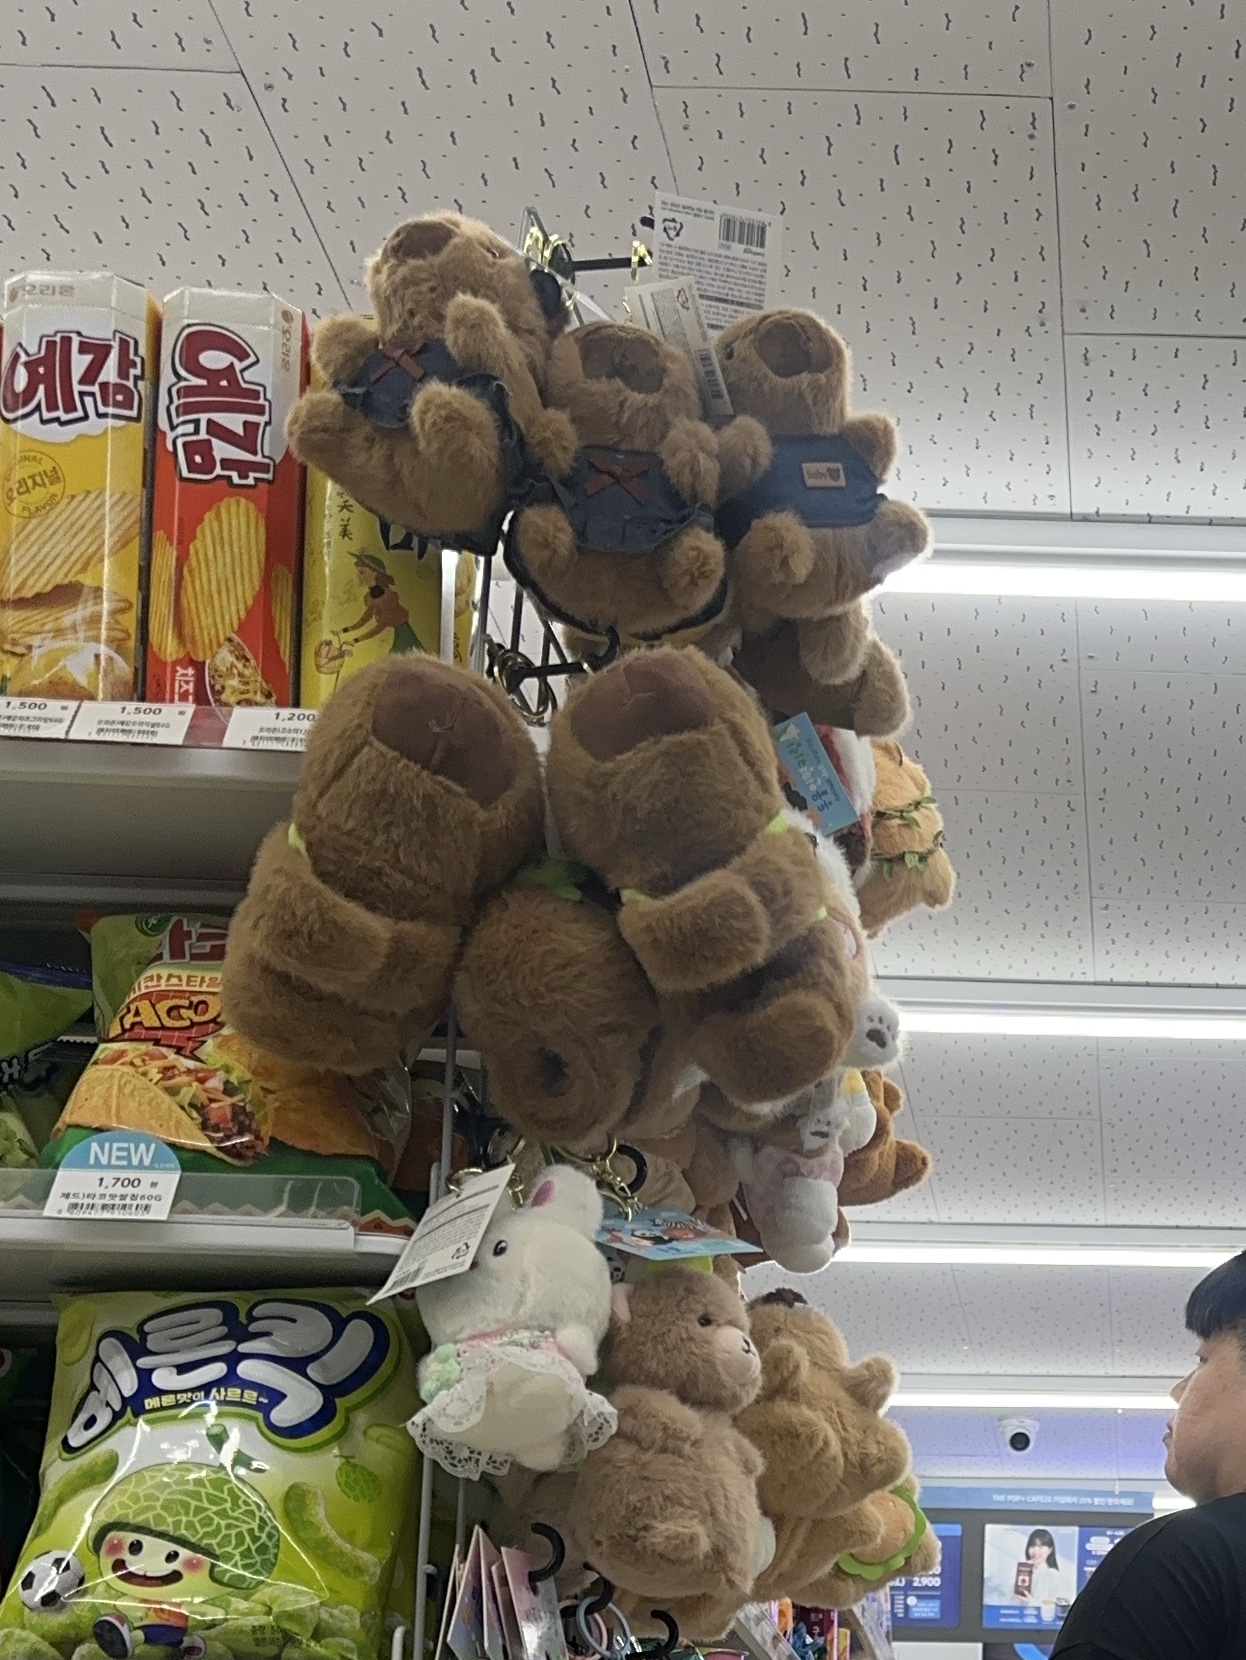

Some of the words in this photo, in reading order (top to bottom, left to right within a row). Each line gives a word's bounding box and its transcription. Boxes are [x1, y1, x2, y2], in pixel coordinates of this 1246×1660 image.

[2, 332, 141, 418] 예감
[173, 326, 272, 484] 예감
[120, 706, 162, 715] 1,500
[274, 712, 317, 722] 1,200
[88, 1141, 157, 1167] NEW
[97, 1177, 142, 1190] 1,700
[65, 1300, 376, 1449] 메론킥
